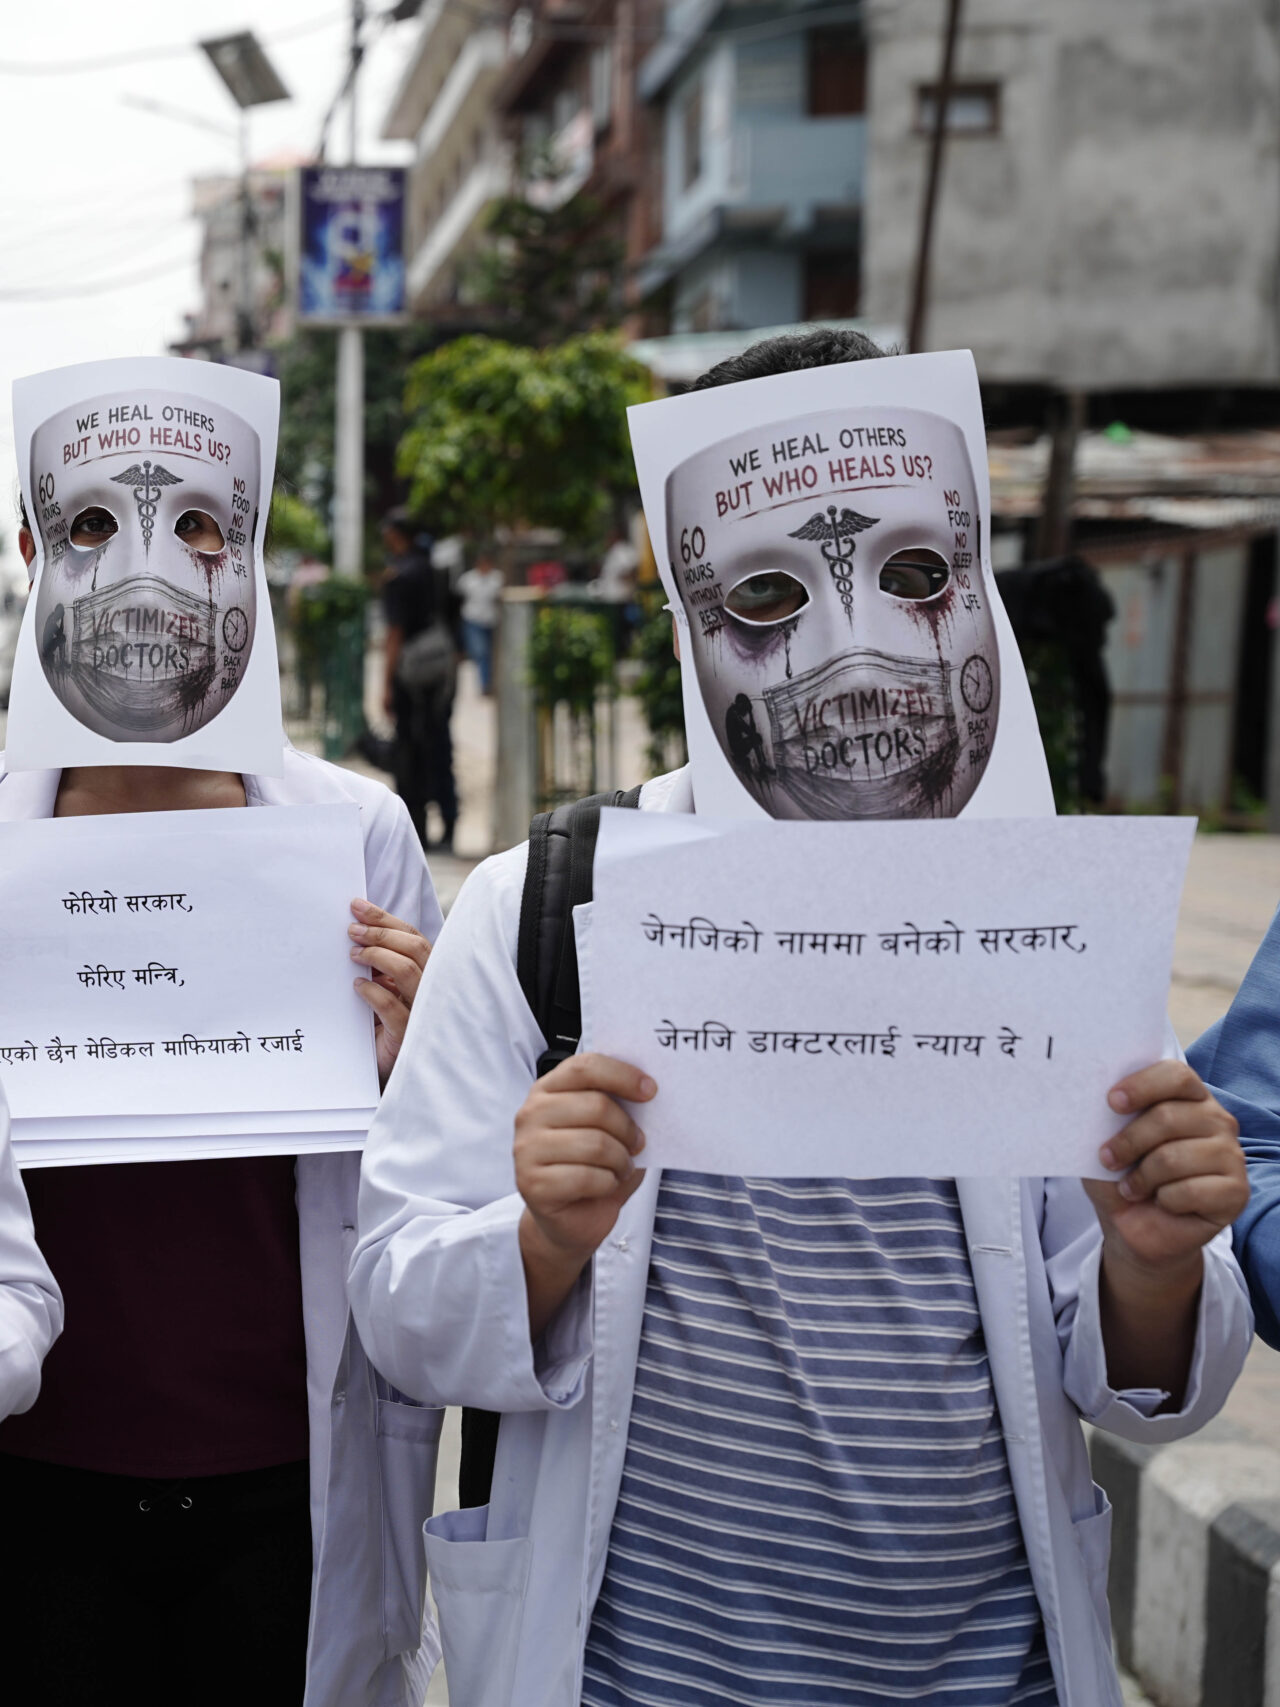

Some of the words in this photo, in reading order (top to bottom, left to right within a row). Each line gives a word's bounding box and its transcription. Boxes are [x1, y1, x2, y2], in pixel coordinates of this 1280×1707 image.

[76, 411, 99, 433] WE
[108, 404, 153, 424] HEAL
[162, 405, 215, 433] OTHERS
[63, 436, 91, 465] BUT
[98, 427, 141, 450] WHO
[150, 427, 202, 452] HEALS
[208, 438, 231, 465] US?
[729, 448, 762, 477] WE
[771, 433, 830, 464] HEAL
[839, 427, 907, 449] OTHERS
[38, 472, 55, 505] 60
[233, 477, 246, 495] NO
[715, 481, 753, 518] BUT
[762, 465, 818, 499] WHO
[828, 454, 896, 483] HEALS
[903, 455, 933, 480] US?
[232, 493, 250, 514] FOOD
[943, 490, 961, 507] NO
[41, 501, 62, 521] HOURS
[232, 512, 244, 529] NO
[948, 510, 971, 528] FOOD
[226, 528, 247, 546] SLEEP
[680, 526, 705, 564] 60
[955, 532, 967, 548] NO
[230, 546, 242, 561] NO
[952, 552, 973, 568] SLEEP
[231, 561, 248, 578] LIFE
[683, 562, 714, 586] HOURS
[956, 573, 970, 590] NO
[687, 583, 723, 606] WITHOUT
[960, 593, 981, 611] LIFE
[94, 642, 190, 670] DOCTORS
[223, 655, 241, 668] BACK
[228, 667, 236, 677] TO
[221, 677, 239, 690] BACK
[968, 719, 990, 735] BACK
[973, 733, 985, 746] TO
[803, 727, 927, 774] DOCTORS
[62, 890, 118, 914] फेरियो
[124, 894, 192, 912] सरकार,
[642, 914, 763, 953] जेनजिको
[775, 932, 866, 955] नाममा
[878, 920, 964, 955] बनेको
[976, 925, 1086, 953] सरकार,
[76, 965, 126, 990] फेरिए
[132, 962, 184, 986] मन्त्रि,
[45, 1036, 77, 1063] छैन
[84, 1037, 154, 1058] मेडिकल
[162, 1031, 251, 1055] माफियाको
[257, 1029, 304, 1052] रजाई
[656, 1020, 736, 1051] जेनजि
[748, 1026, 901, 1057] डाक्टरलाई
[913, 1035, 985, 1056] न्याय
[998, 1027, 1022, 1058] दे
